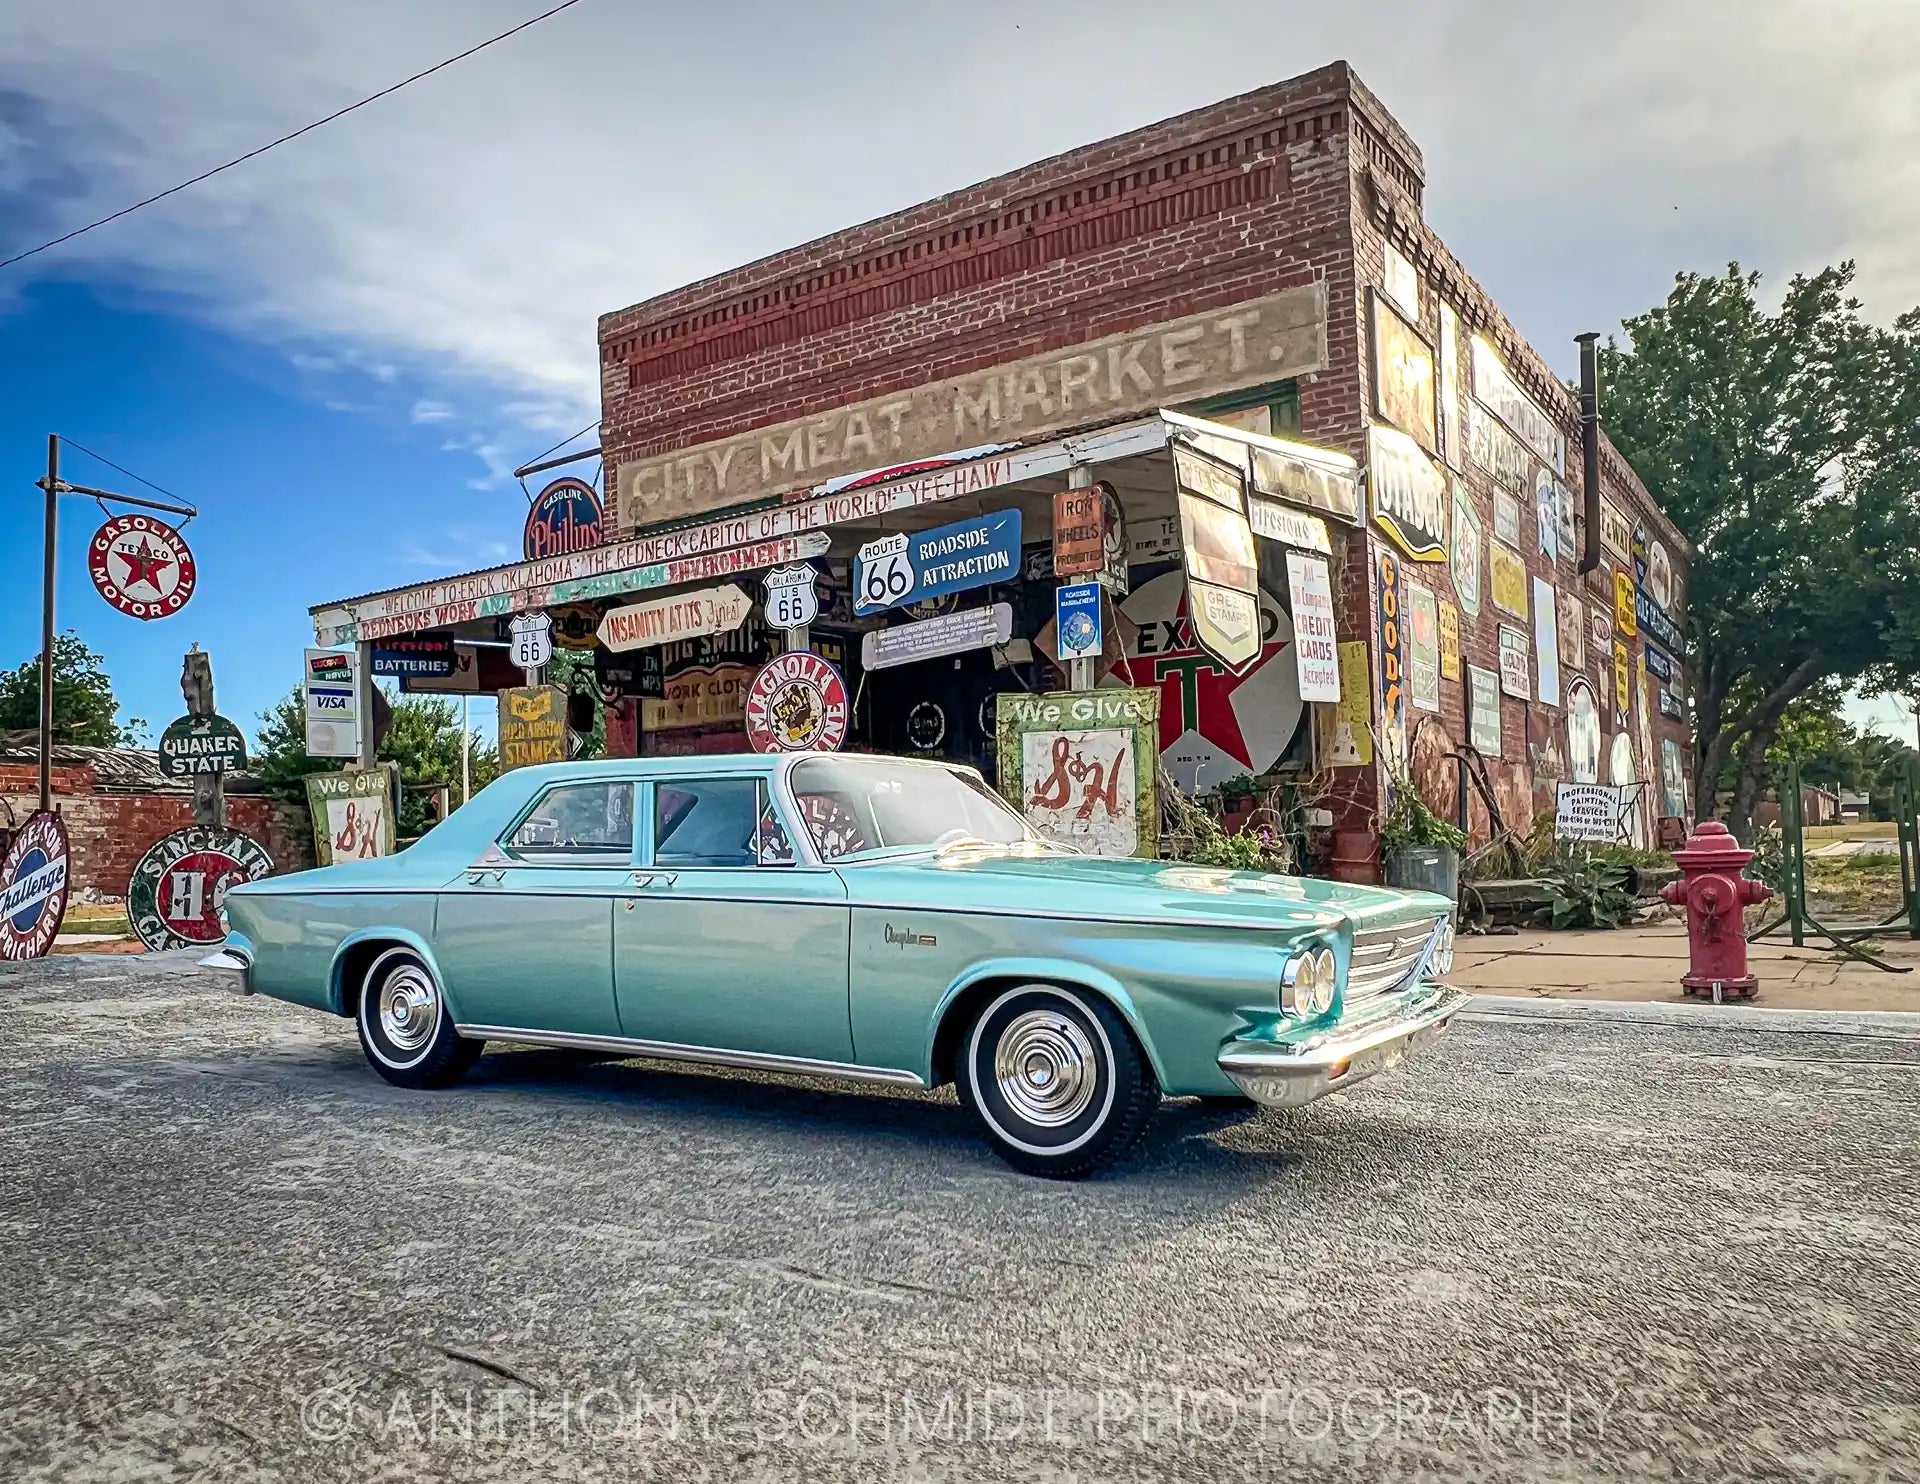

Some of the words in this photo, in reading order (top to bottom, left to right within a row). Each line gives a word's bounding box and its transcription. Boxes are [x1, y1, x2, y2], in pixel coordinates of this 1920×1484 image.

[632, 443, 739, 506] CITY
[762, 402, 912, 478] MEAT
[543, 489, 582, 509] GASOLINE
[95, 517, 192, 564] GASOLINE
[919, 527, 990, 560] ROADSIDE
[1057, 523, 1099, 544] WHEELS
[385, 588, 437, 613] WELCOME
[690, 521, 752, 555] CAPITOL
[760, 515, 779, 537] OF
[790, 506, 818, 531] THE
[865, 538, 902, 559] ROUTE
[867, 556, 907, 601] 66
[923, 550, 1010, 587] ATTRACTION
[93, 567, 162, 616] MOTOR
[169, 580, 193, 608] OIL
[778, 598, 803, 622] 66
[607, 607, 666, 645] INSANITY
[670, 606, 686, 633] AT
[1295, 612, 1333, 638] CREDIT
[520, 642, 540, 662] 66
[1301, 639, 1333, 661] CARDS
[325, 670, 352, 681] NOVUS
[375, 658, 449, 672] BATTERIES
[1304, 663, 1335, 690] Accepted
[317, 696, 346, 710] VISA
[1155, 654, 1225, 734] T
[1015, 700, 1061, 723] We
[1071, 699, 1142, 721] Give
[163, 736, 240, 758] QUAKER
[172, 756, 236, 774] STATE
[318, 777, 350, 794] We
[355, 775, 387, 791] Give
[1030, 736, 1127, 820] S&H
[1561, 787, 1617, 805] PROFESSIONAL
[1571, 797, 1609, 809] PAINTING
[142, 831, 271, 881] SINCLAIR
